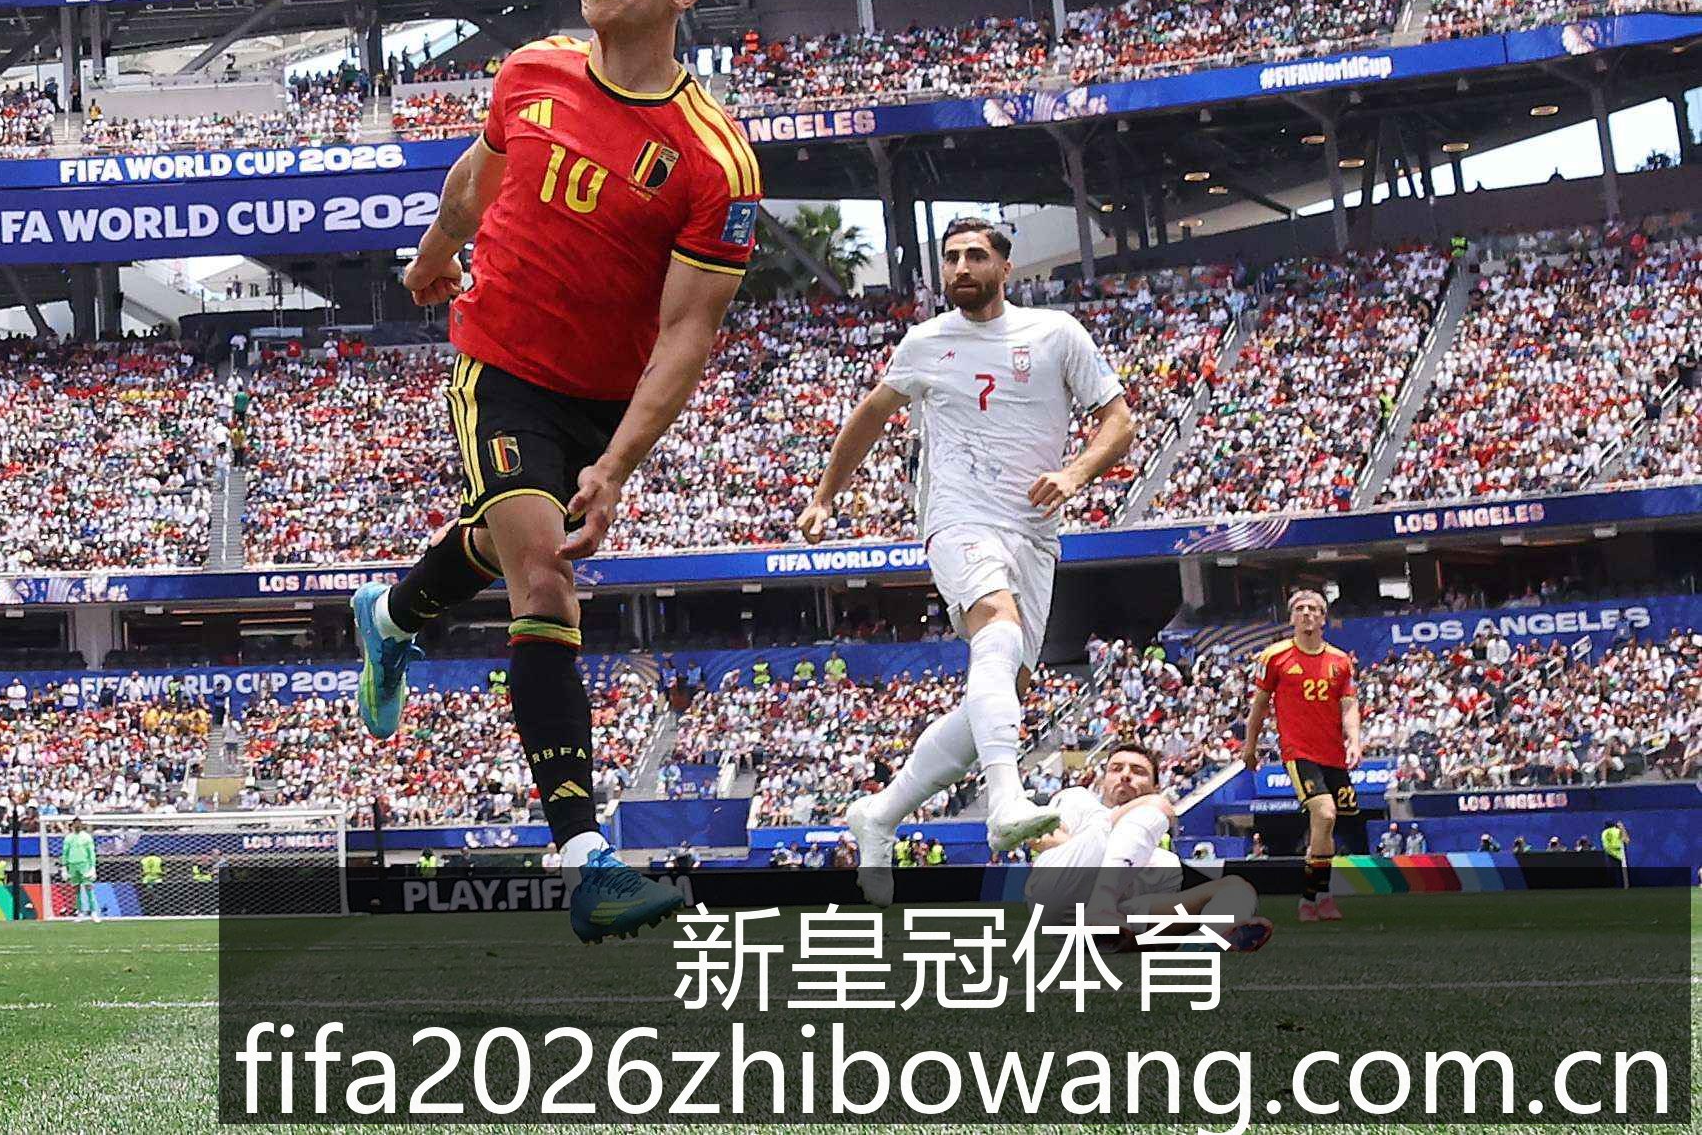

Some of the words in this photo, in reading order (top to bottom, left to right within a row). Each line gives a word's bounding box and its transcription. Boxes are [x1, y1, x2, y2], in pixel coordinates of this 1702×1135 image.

[1259, 56, 1392, 90] #FIFAWorldCup
[60, 158, 123, 185] FIFA
[126, 153, 240, 181] WORLD
[242, 150, 296, 176] CUP
[298, 145, 404, 173] 2026
[539, 143, 609, 214] 10
[58, 204, 220, 241] WORLD
[227, 199, 316, 235] CUP
[324, 193, 440, 231] 202
[974, 373, 996, 412] 7
[1394, 513, 1437, 534] LOS
[766, 553, 812, 573] FIFA
[812, 550, 887, 570] WORLD
[258, 575, 300, 593] LOS
[1391, 620, 1464, 644] LOS
[1473, 607, 1651, 637] ANGELES
[290, 670, 360, 692] 202
[1302, 679, 1329, 702] 22
[1458, 795, 1491, 811] LOS
